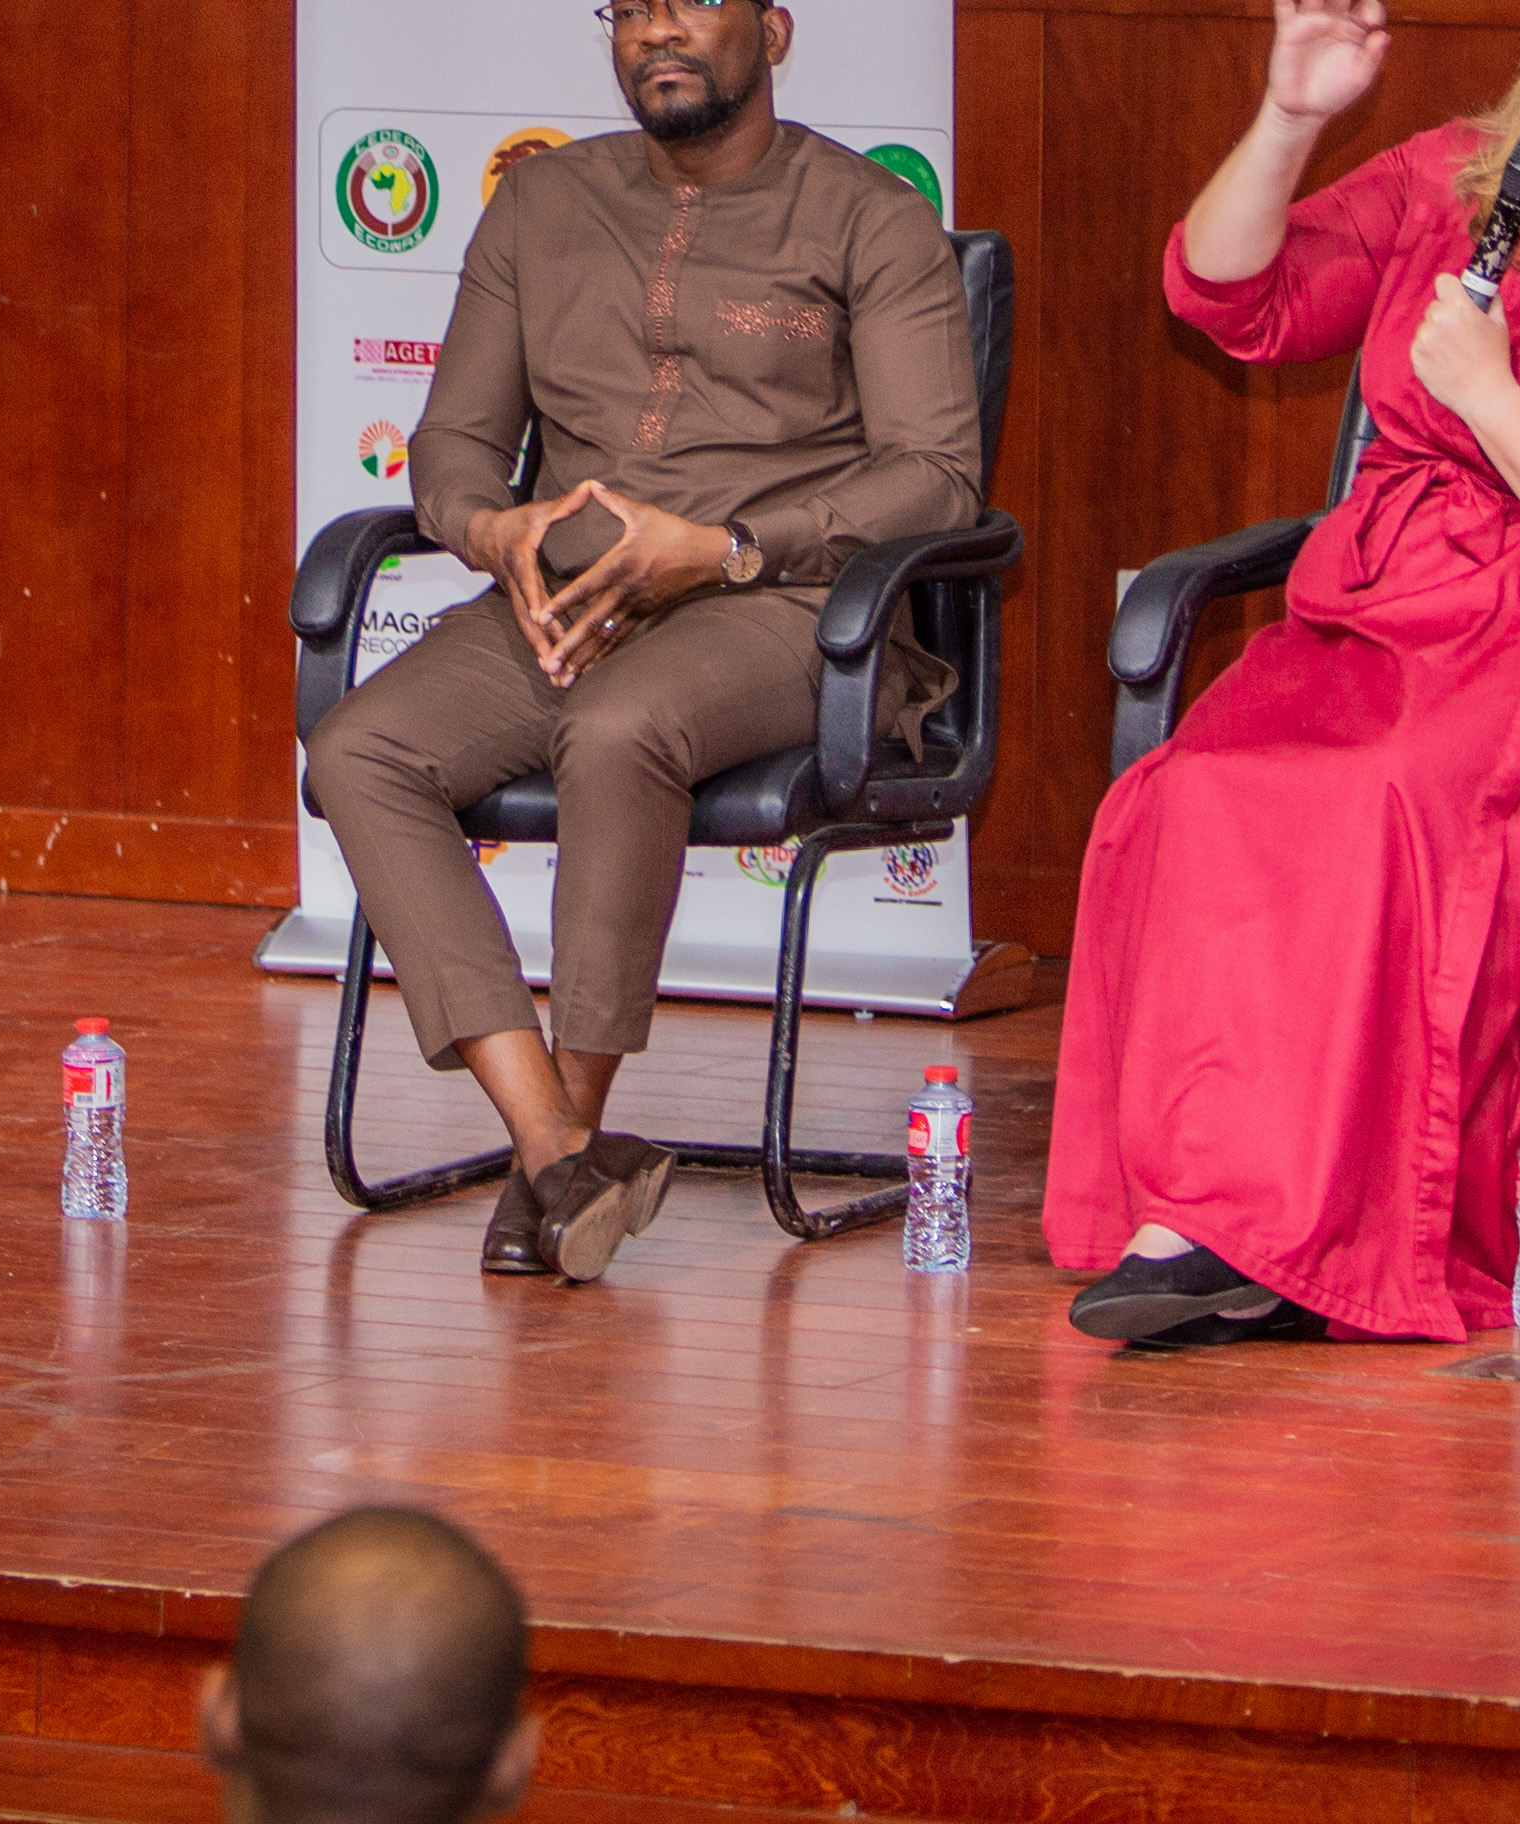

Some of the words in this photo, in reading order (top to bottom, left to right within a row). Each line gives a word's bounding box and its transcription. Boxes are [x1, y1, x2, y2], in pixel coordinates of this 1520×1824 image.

[355, 130, 425, 160] CEDEAO
[354, 224, 424, 252] ECOWAS
[387, 342, 441, 363] AGET
